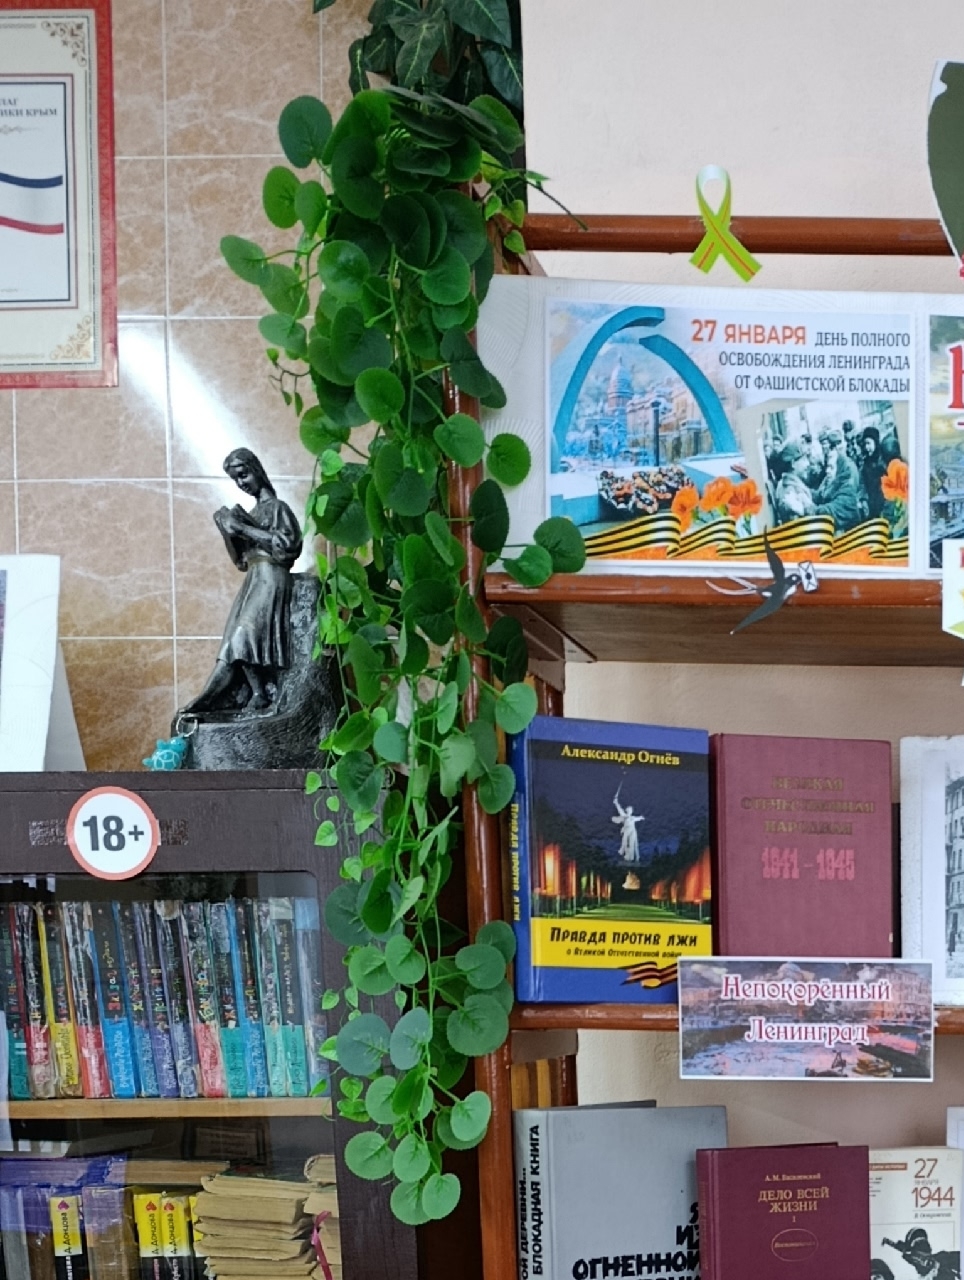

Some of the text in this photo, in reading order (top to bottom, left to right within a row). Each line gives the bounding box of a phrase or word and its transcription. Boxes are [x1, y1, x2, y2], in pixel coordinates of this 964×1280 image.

[690, 319, 911, 348] 27 ЯНВАРЯ ДЕНЬ ПОЛНОГО
[718, 351, 911, 371] ОСВОБОЖДЕНИЯ ЛЕНИНГРАДА
[733, 373, 911, 395] ОТ ФАШИСТСКОЙ БЛОКАДЫ
[561, 745, 680, 766] Александр Огнёв
[82, 814, 145, 852] 18+
[761, 847, 855, 881] 1941 1945
[612, 931, 661, 946] ПРОТИВ
[666, 934, 698, 947] ЛЖИ
[721, 975, 892, 1006] Непокорённый
[744, 1016, 871, 1046] Ленинград
[913, 1157, 938, 1179] 27
[529, 1124, 544, 1275] БЛОКАДНАЯ КНИГА
[758, 1186, 830, 1203] ДЕЛО ВСЕЙ
[911, 1186, 955, 1209] 1944
[769, 1201, 818, 1213] ЖИЗНИ
[59, 1211, 71, 1246] Донцова
